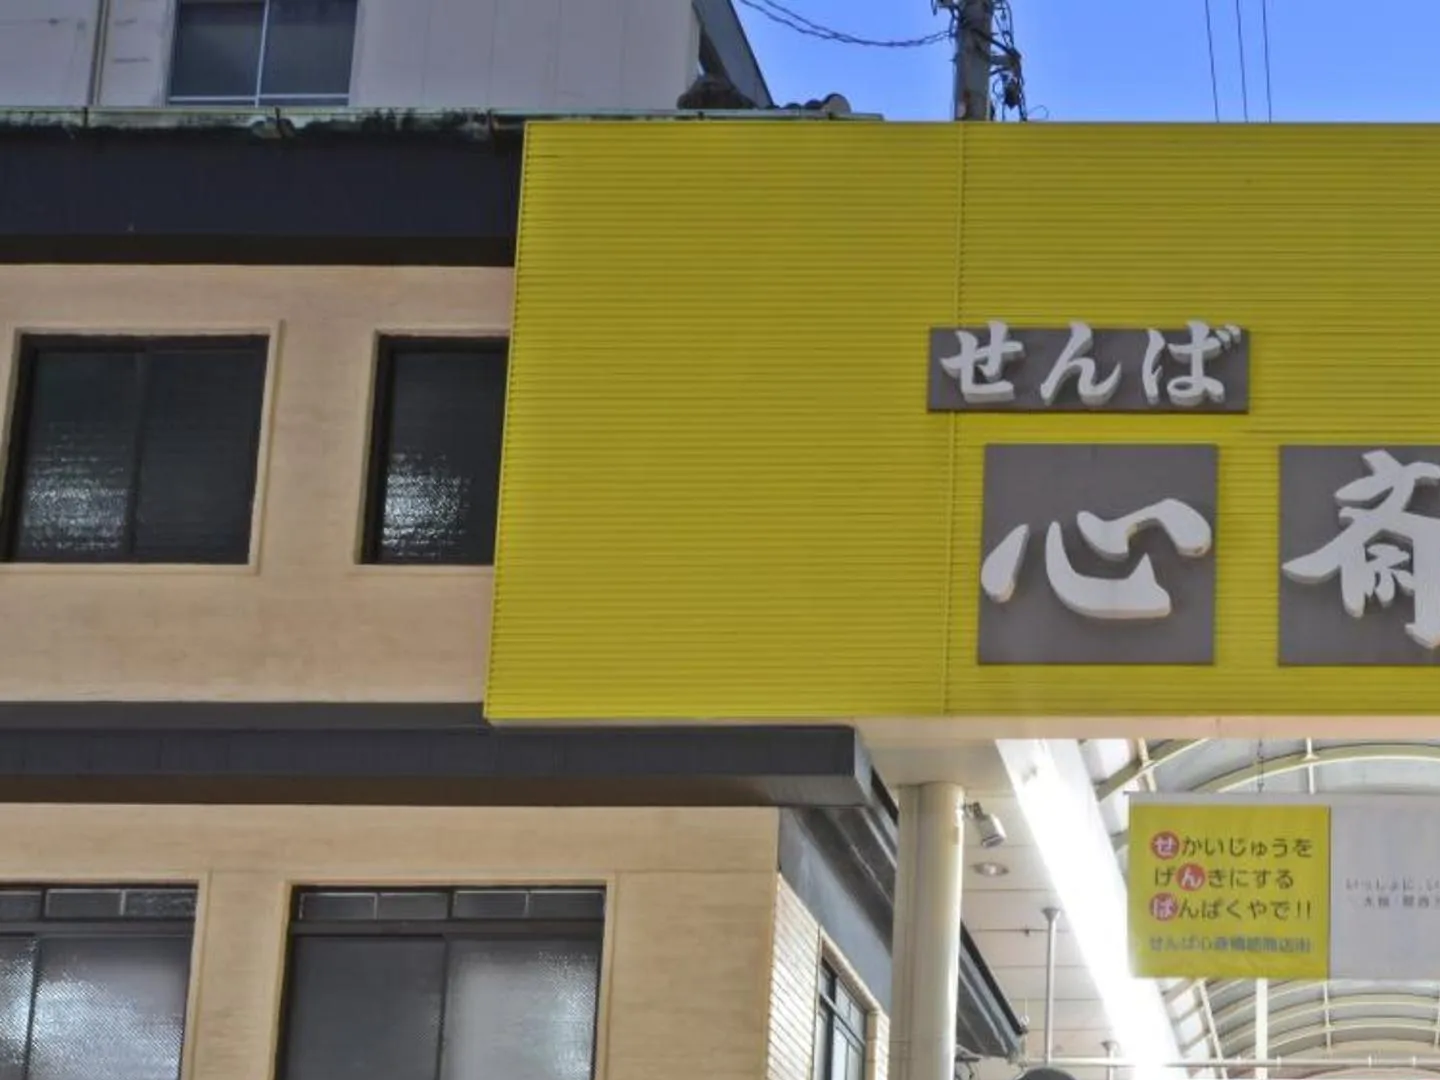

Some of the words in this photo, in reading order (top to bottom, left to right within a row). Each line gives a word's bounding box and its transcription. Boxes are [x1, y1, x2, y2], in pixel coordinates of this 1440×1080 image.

[939, 320, 1243, 405] せんば
[1151, 832, 1313, 859] せかいじゅうを
[1154, 864, 1294, 891] げんきにする
